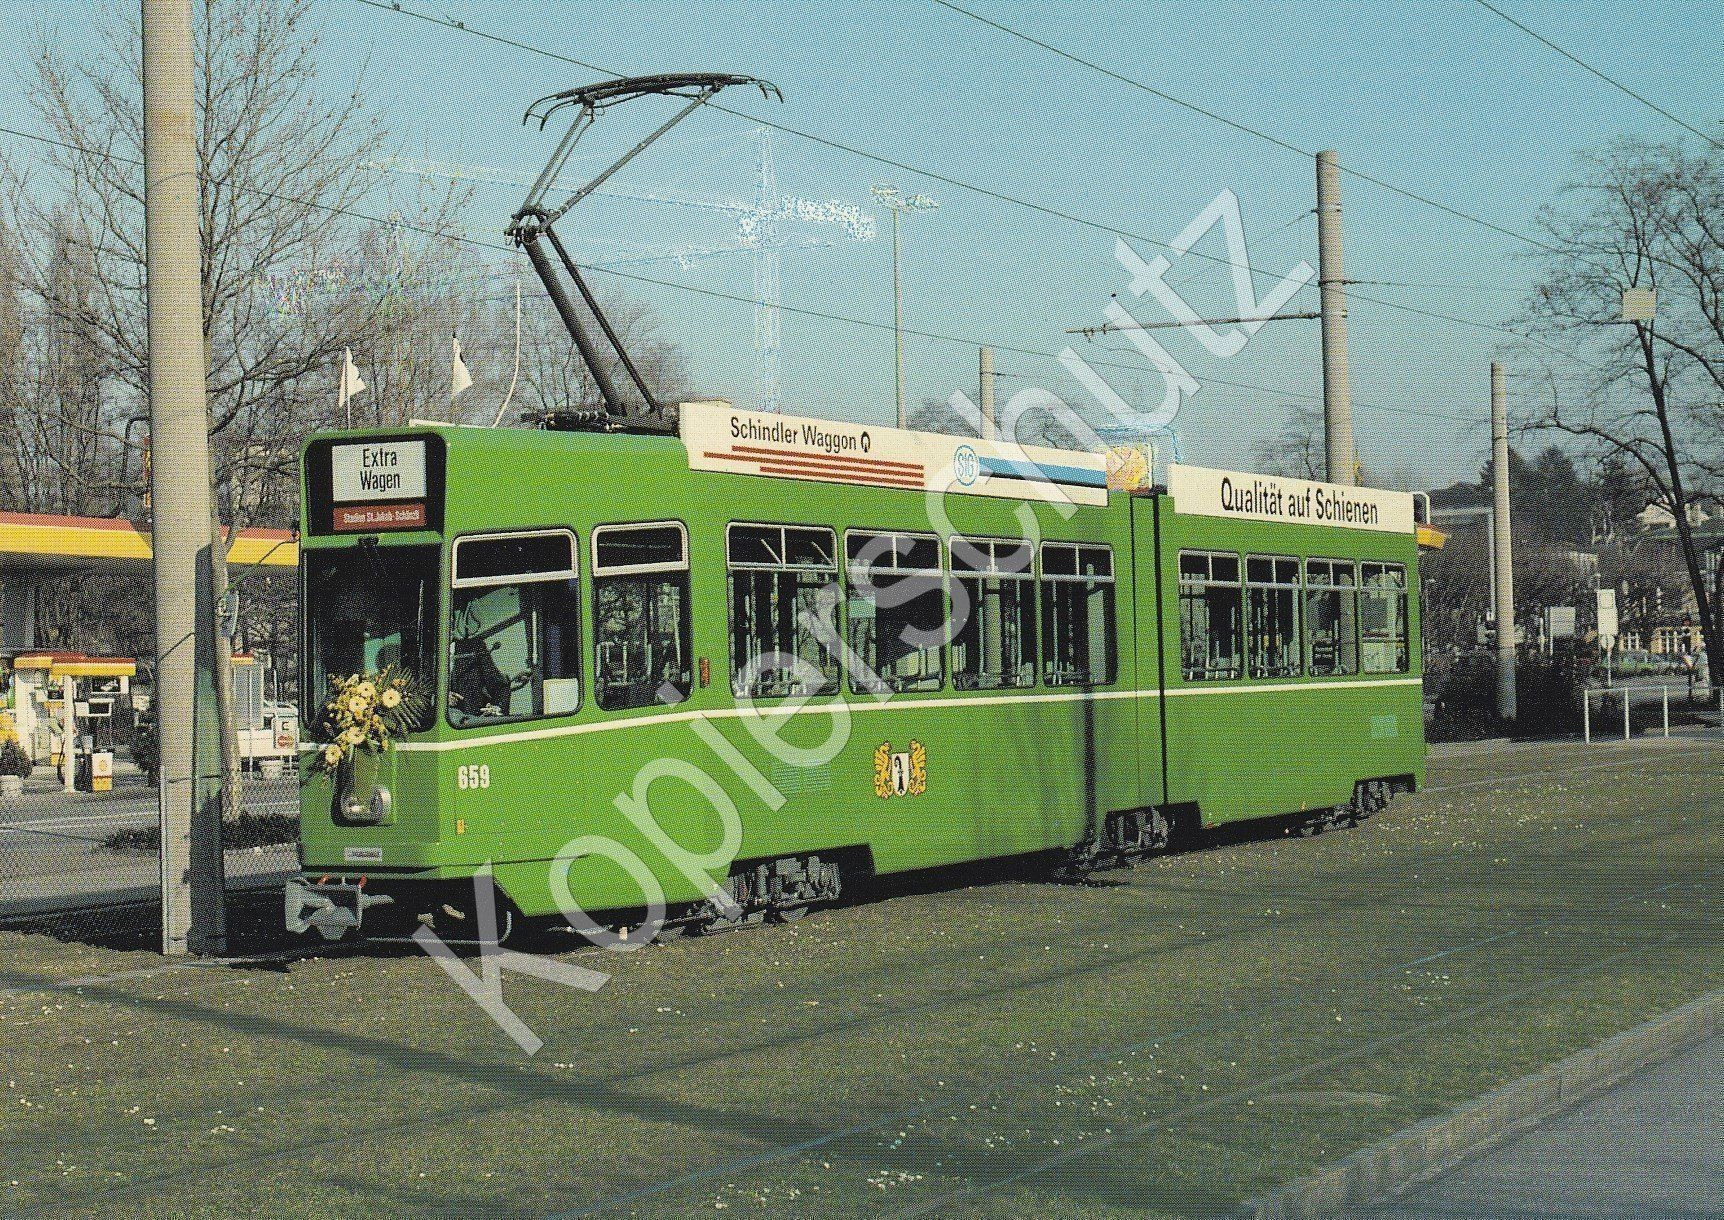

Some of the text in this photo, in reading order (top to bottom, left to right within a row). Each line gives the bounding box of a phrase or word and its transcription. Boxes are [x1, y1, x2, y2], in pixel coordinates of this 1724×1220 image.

[731, 416, 857, 453] Schindler Waggon
[362, 448, 397, 468] Extra
[360, 470, 401, 492] Wagen
[1221, 477, 1379, 525] Qualität auf Schienen
[457, 765, 491, 790] 659
